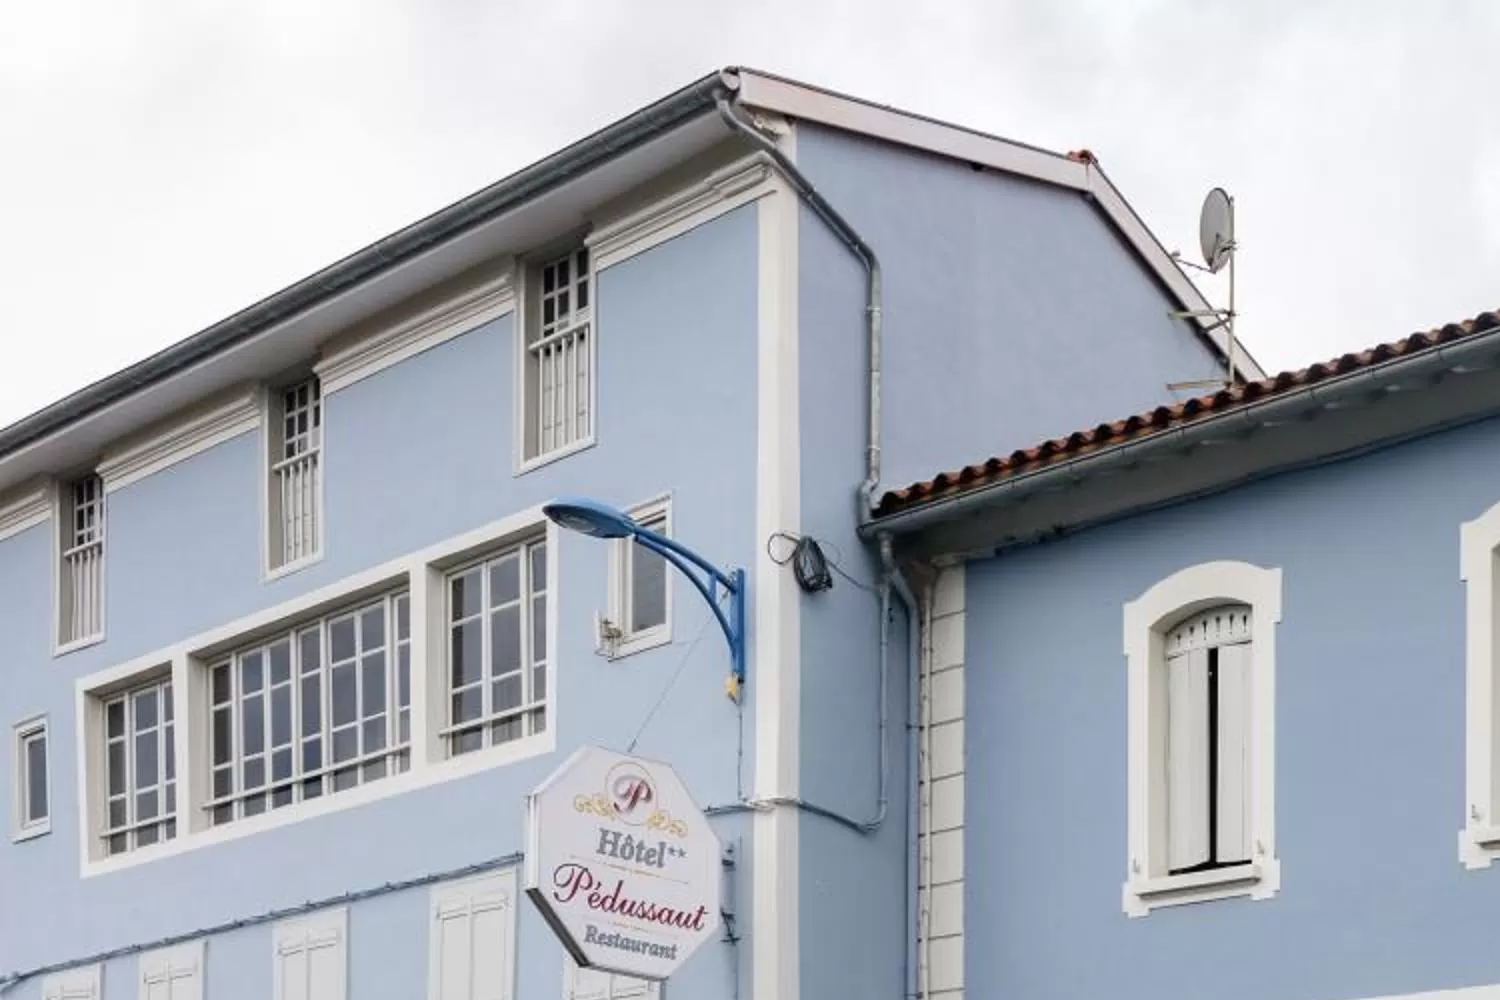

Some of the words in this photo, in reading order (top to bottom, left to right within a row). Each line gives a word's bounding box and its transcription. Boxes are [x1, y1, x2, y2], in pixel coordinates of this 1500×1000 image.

[613, 774, 652, 813] P
[596, 827, 665, 868] Hôtel
[553, 862, 711, 932] Pédussaut
[584, 924, 678, 960] Restaurant
